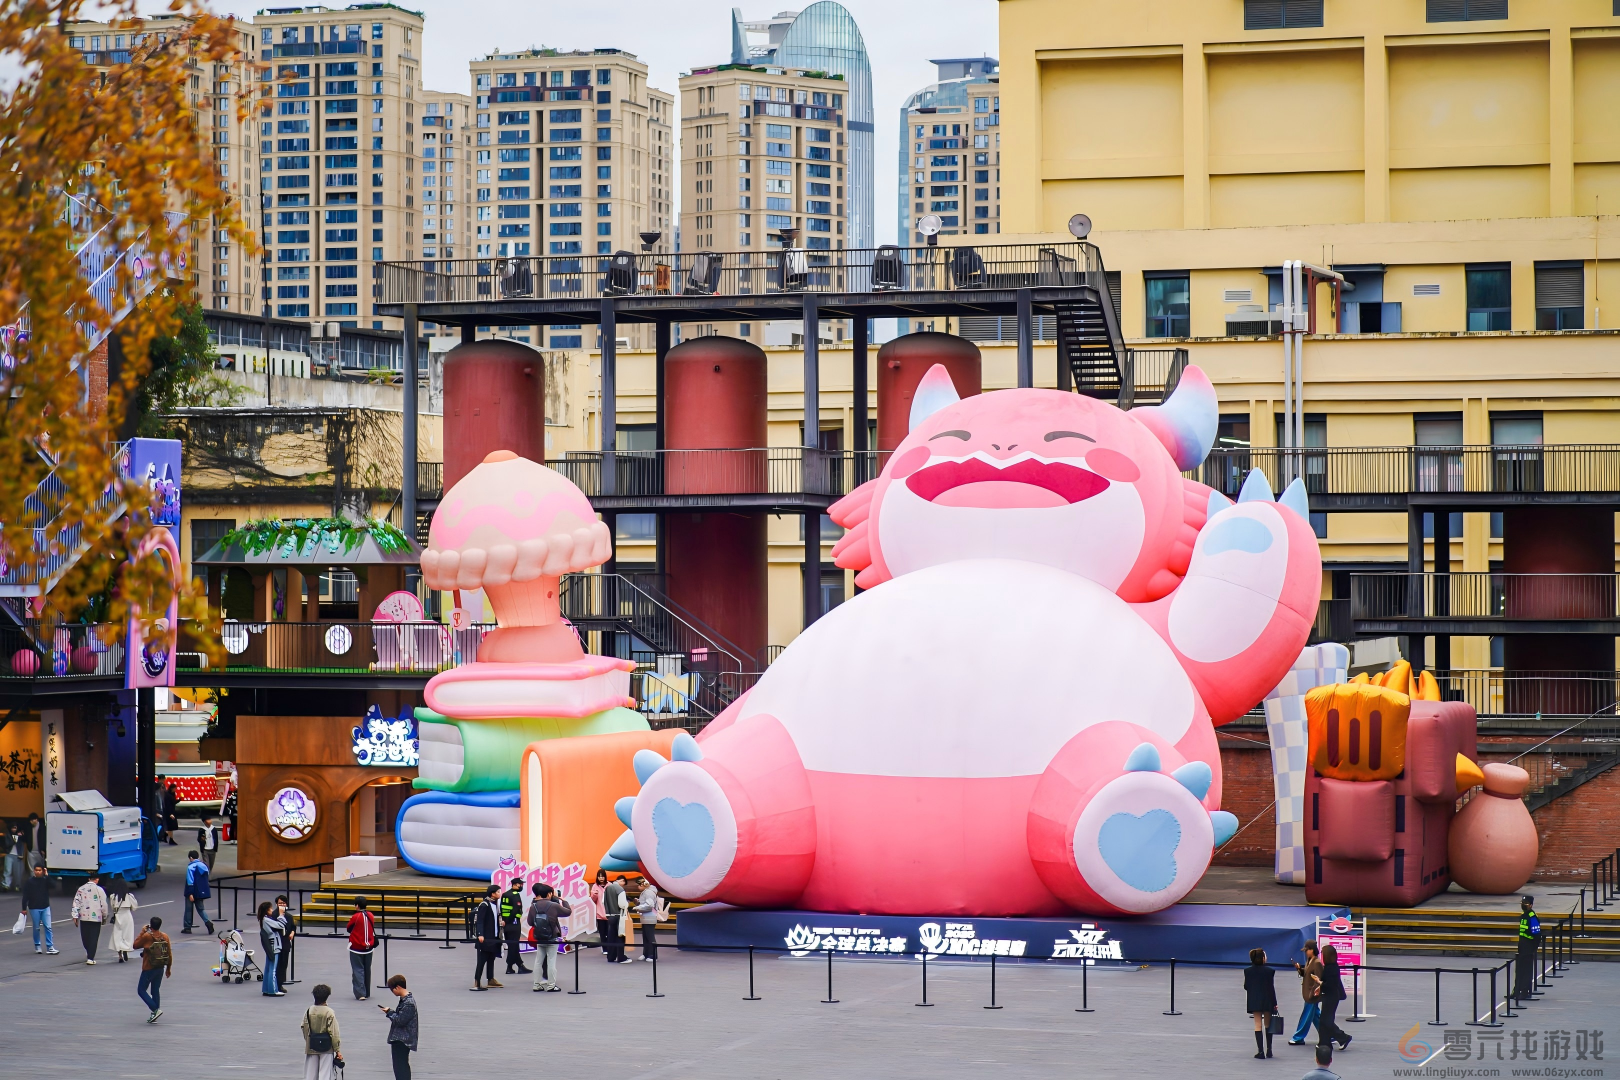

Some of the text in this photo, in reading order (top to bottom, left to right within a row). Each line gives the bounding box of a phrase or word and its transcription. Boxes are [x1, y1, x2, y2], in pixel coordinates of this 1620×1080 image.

[821, 935, 907, 955] 全球总决赛
